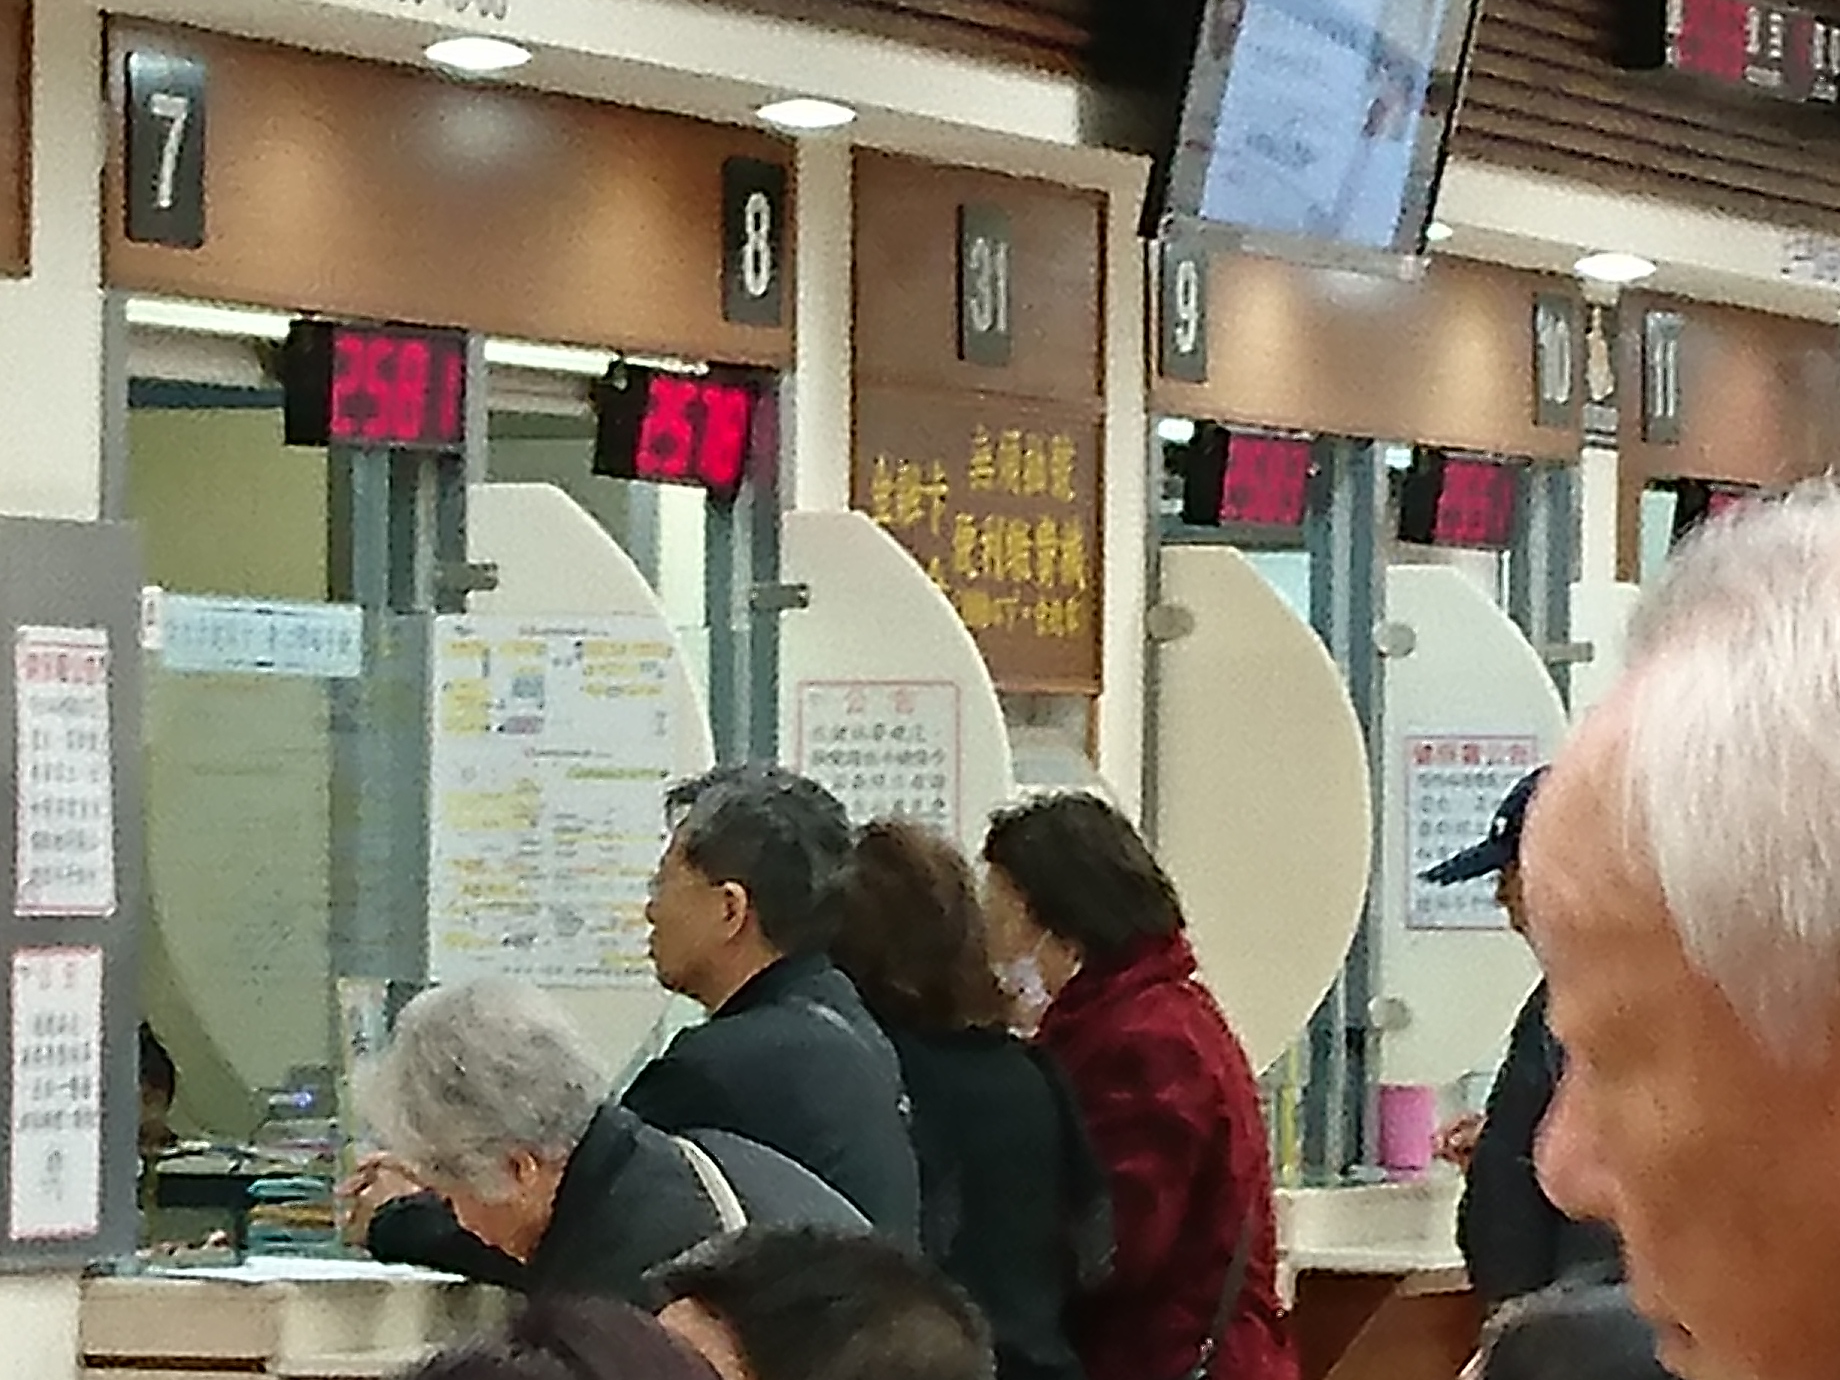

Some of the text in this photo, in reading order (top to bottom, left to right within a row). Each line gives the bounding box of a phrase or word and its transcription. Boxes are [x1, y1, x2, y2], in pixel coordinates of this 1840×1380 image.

[151, 92, 187, 209] 7
[744, 191, 772, 297] 8
[969, 235, 1009, 333] 31
[1175, 259, 1200, 354] 9
